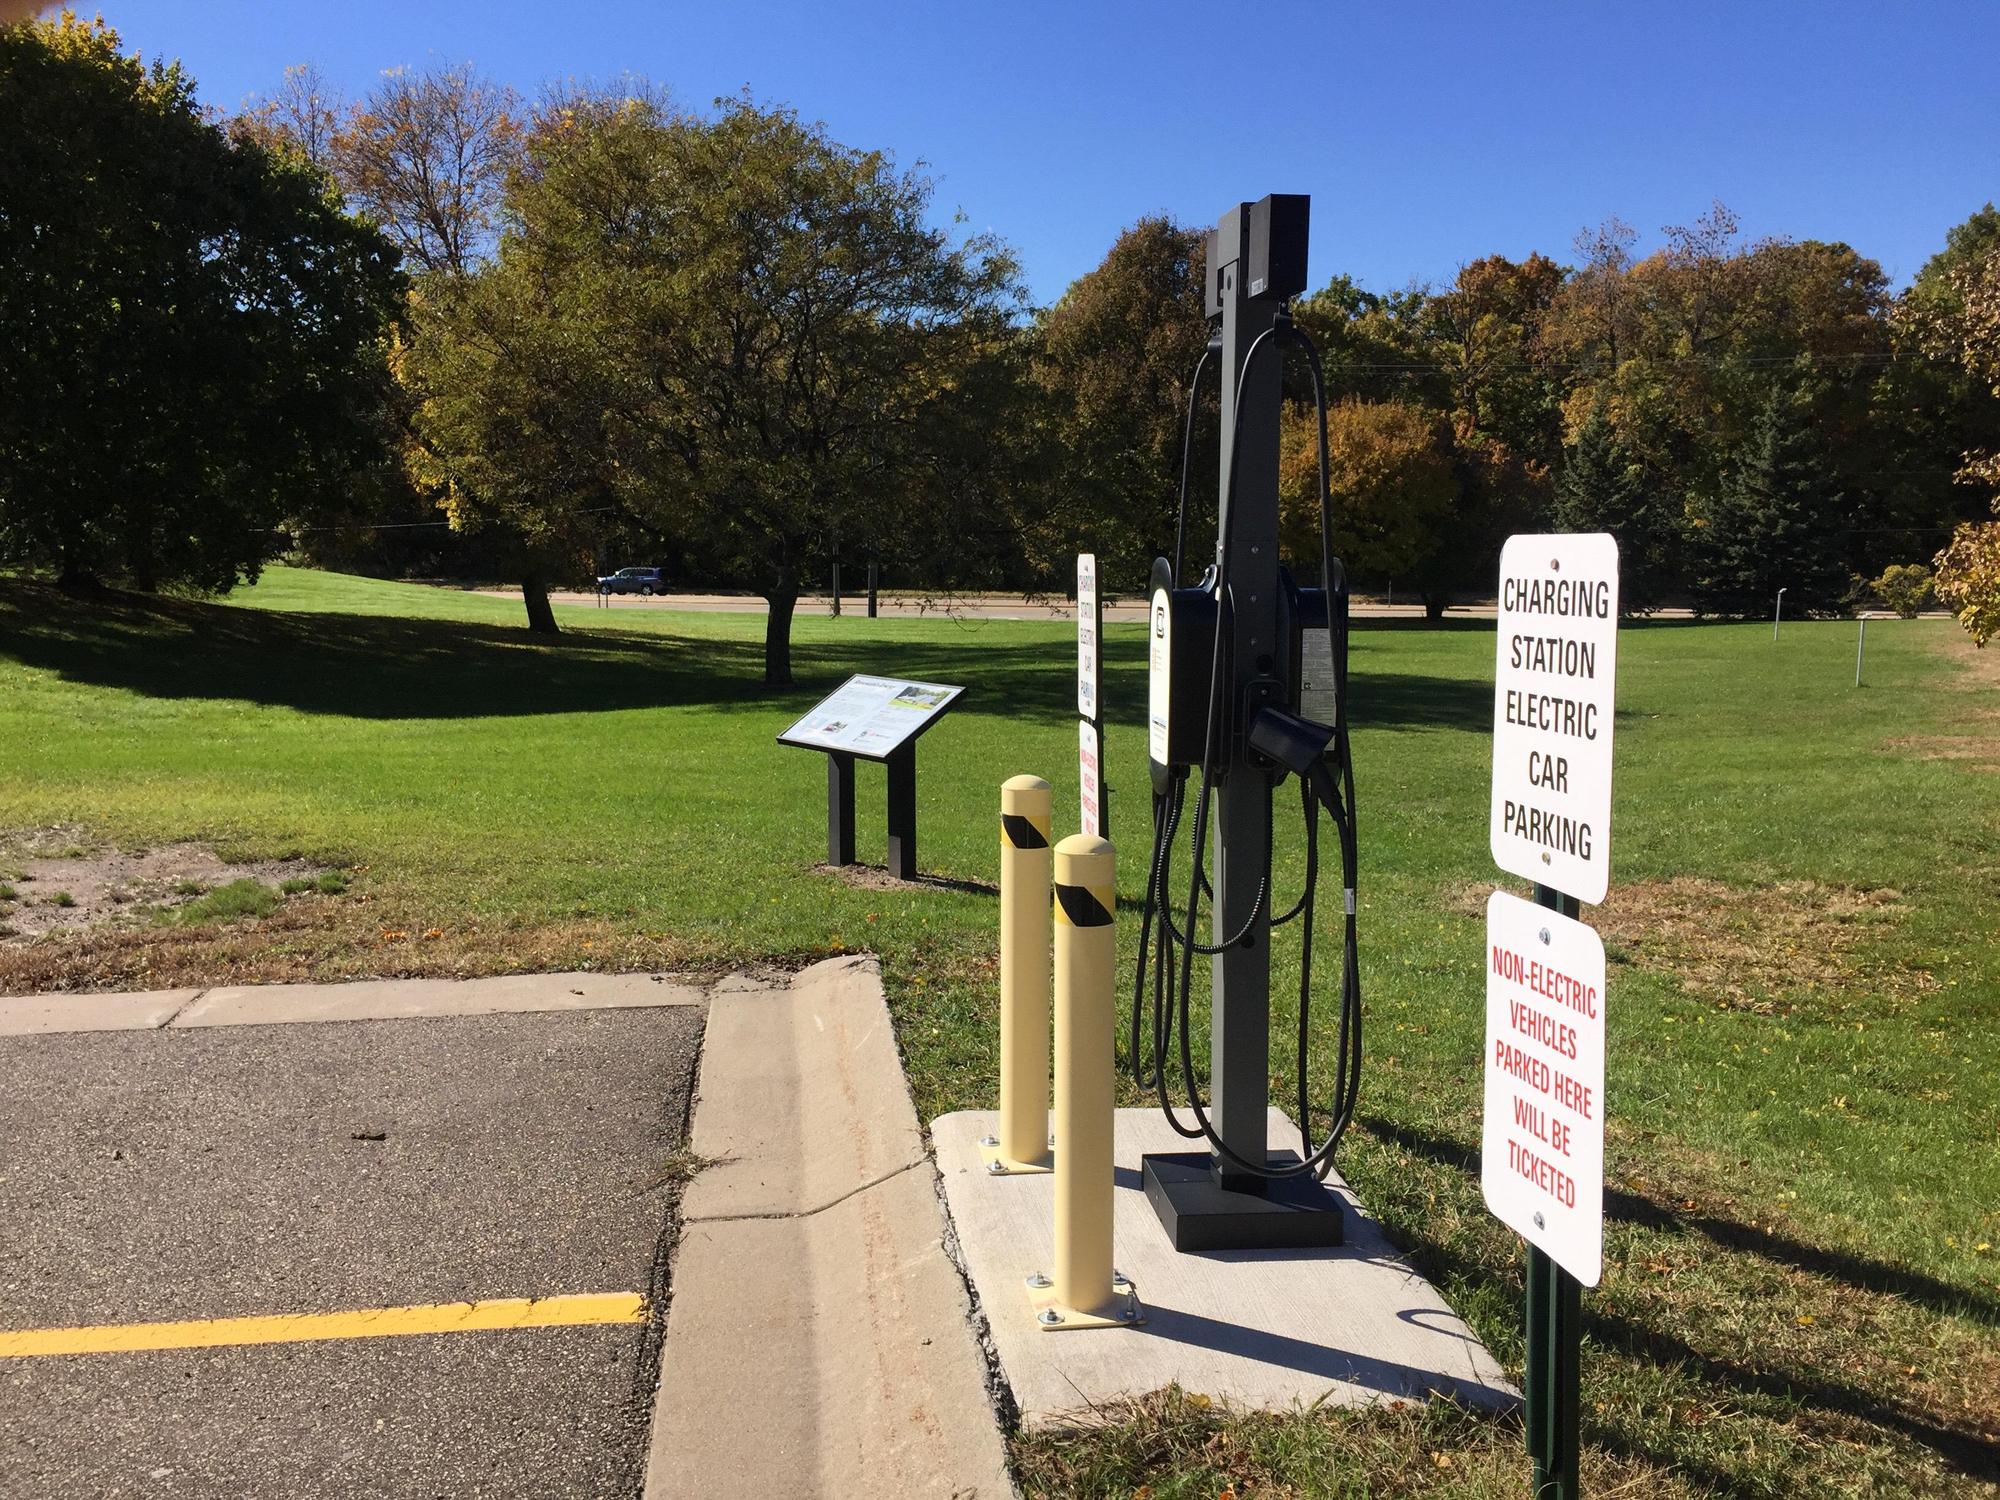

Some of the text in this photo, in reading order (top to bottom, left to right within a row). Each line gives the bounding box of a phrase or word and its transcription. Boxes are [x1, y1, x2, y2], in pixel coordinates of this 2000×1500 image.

[1504, 577, 1609, 619] CHARGING
[1511, 634, 1595, 679] STATION
[1506, 690, 1597, 741] ELECTRIC
[1529, 751, 1568, 794] CAR
[1504, 800, 1592, 861] PARKING
[1492, 945, 1597, 1020] NON-ELECTRIC
[1510, 999, 1577, 1061] VEHICLES
[1495, 1039, 1592, 1121] PARKED HERE
[1514, 1096, 1570, 1157] WILL BE
[1508, 1139, 1576, 1209] TICKETED
